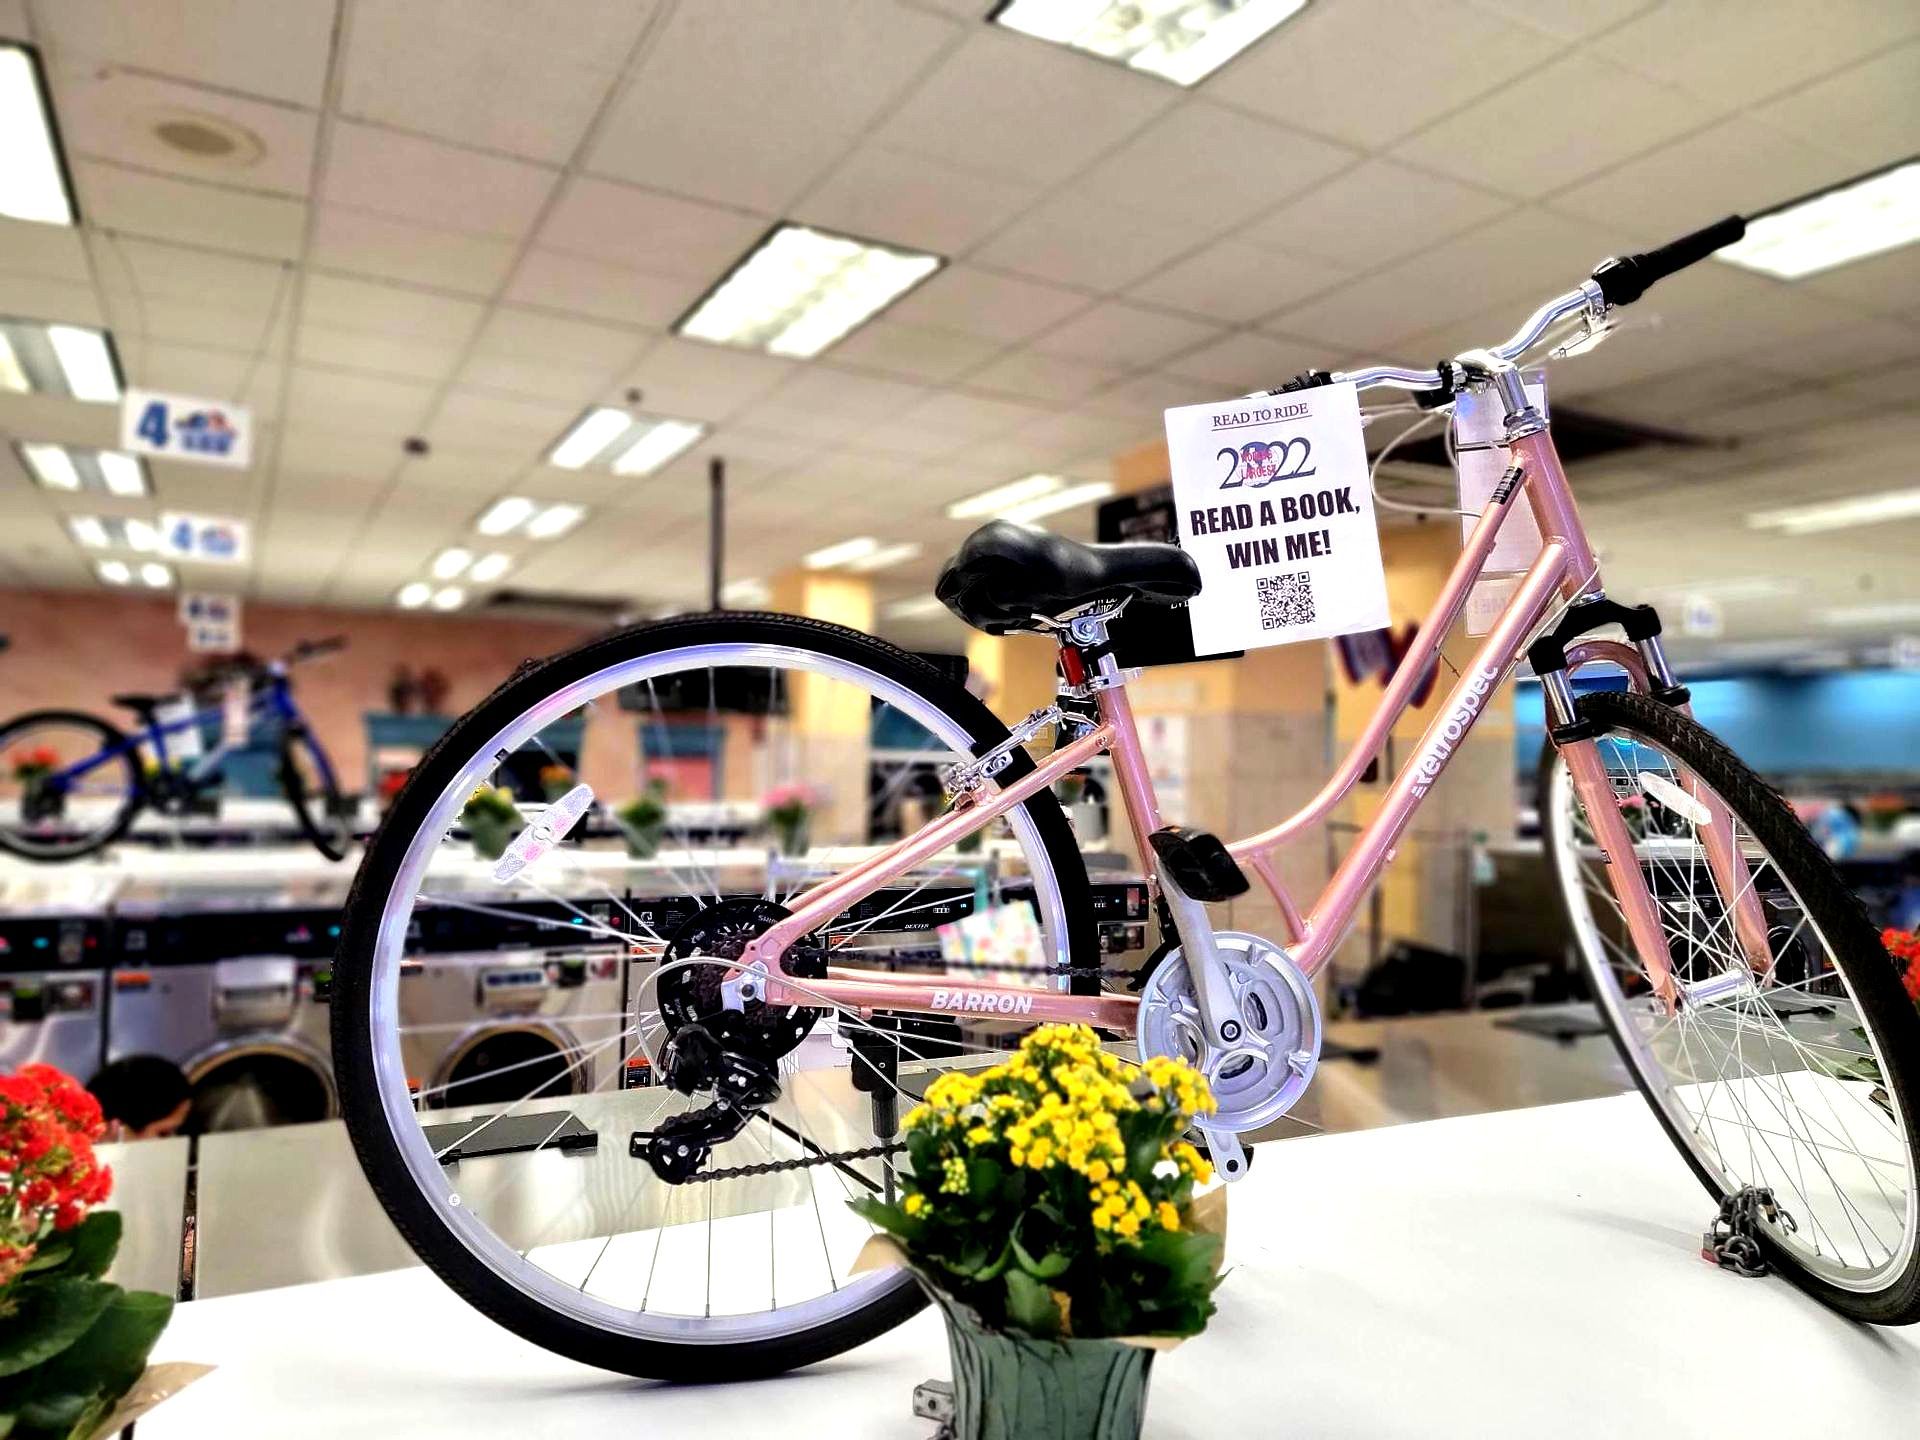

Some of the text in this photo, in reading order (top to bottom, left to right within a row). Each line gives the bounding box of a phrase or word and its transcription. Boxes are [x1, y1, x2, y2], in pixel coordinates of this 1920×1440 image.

[136, 399, 170, 447] 4
[1212, 402, 1309, 427] READ TO RIDE
[1189, 503, 1254, 536] READ
[1260, 499, 1278, 527] A
[1280, 486, 1361, 523] BOOK,
[1225, 528, 1332, 570] WIN ME!
[930, 990, 1033, 1014] BARRON
